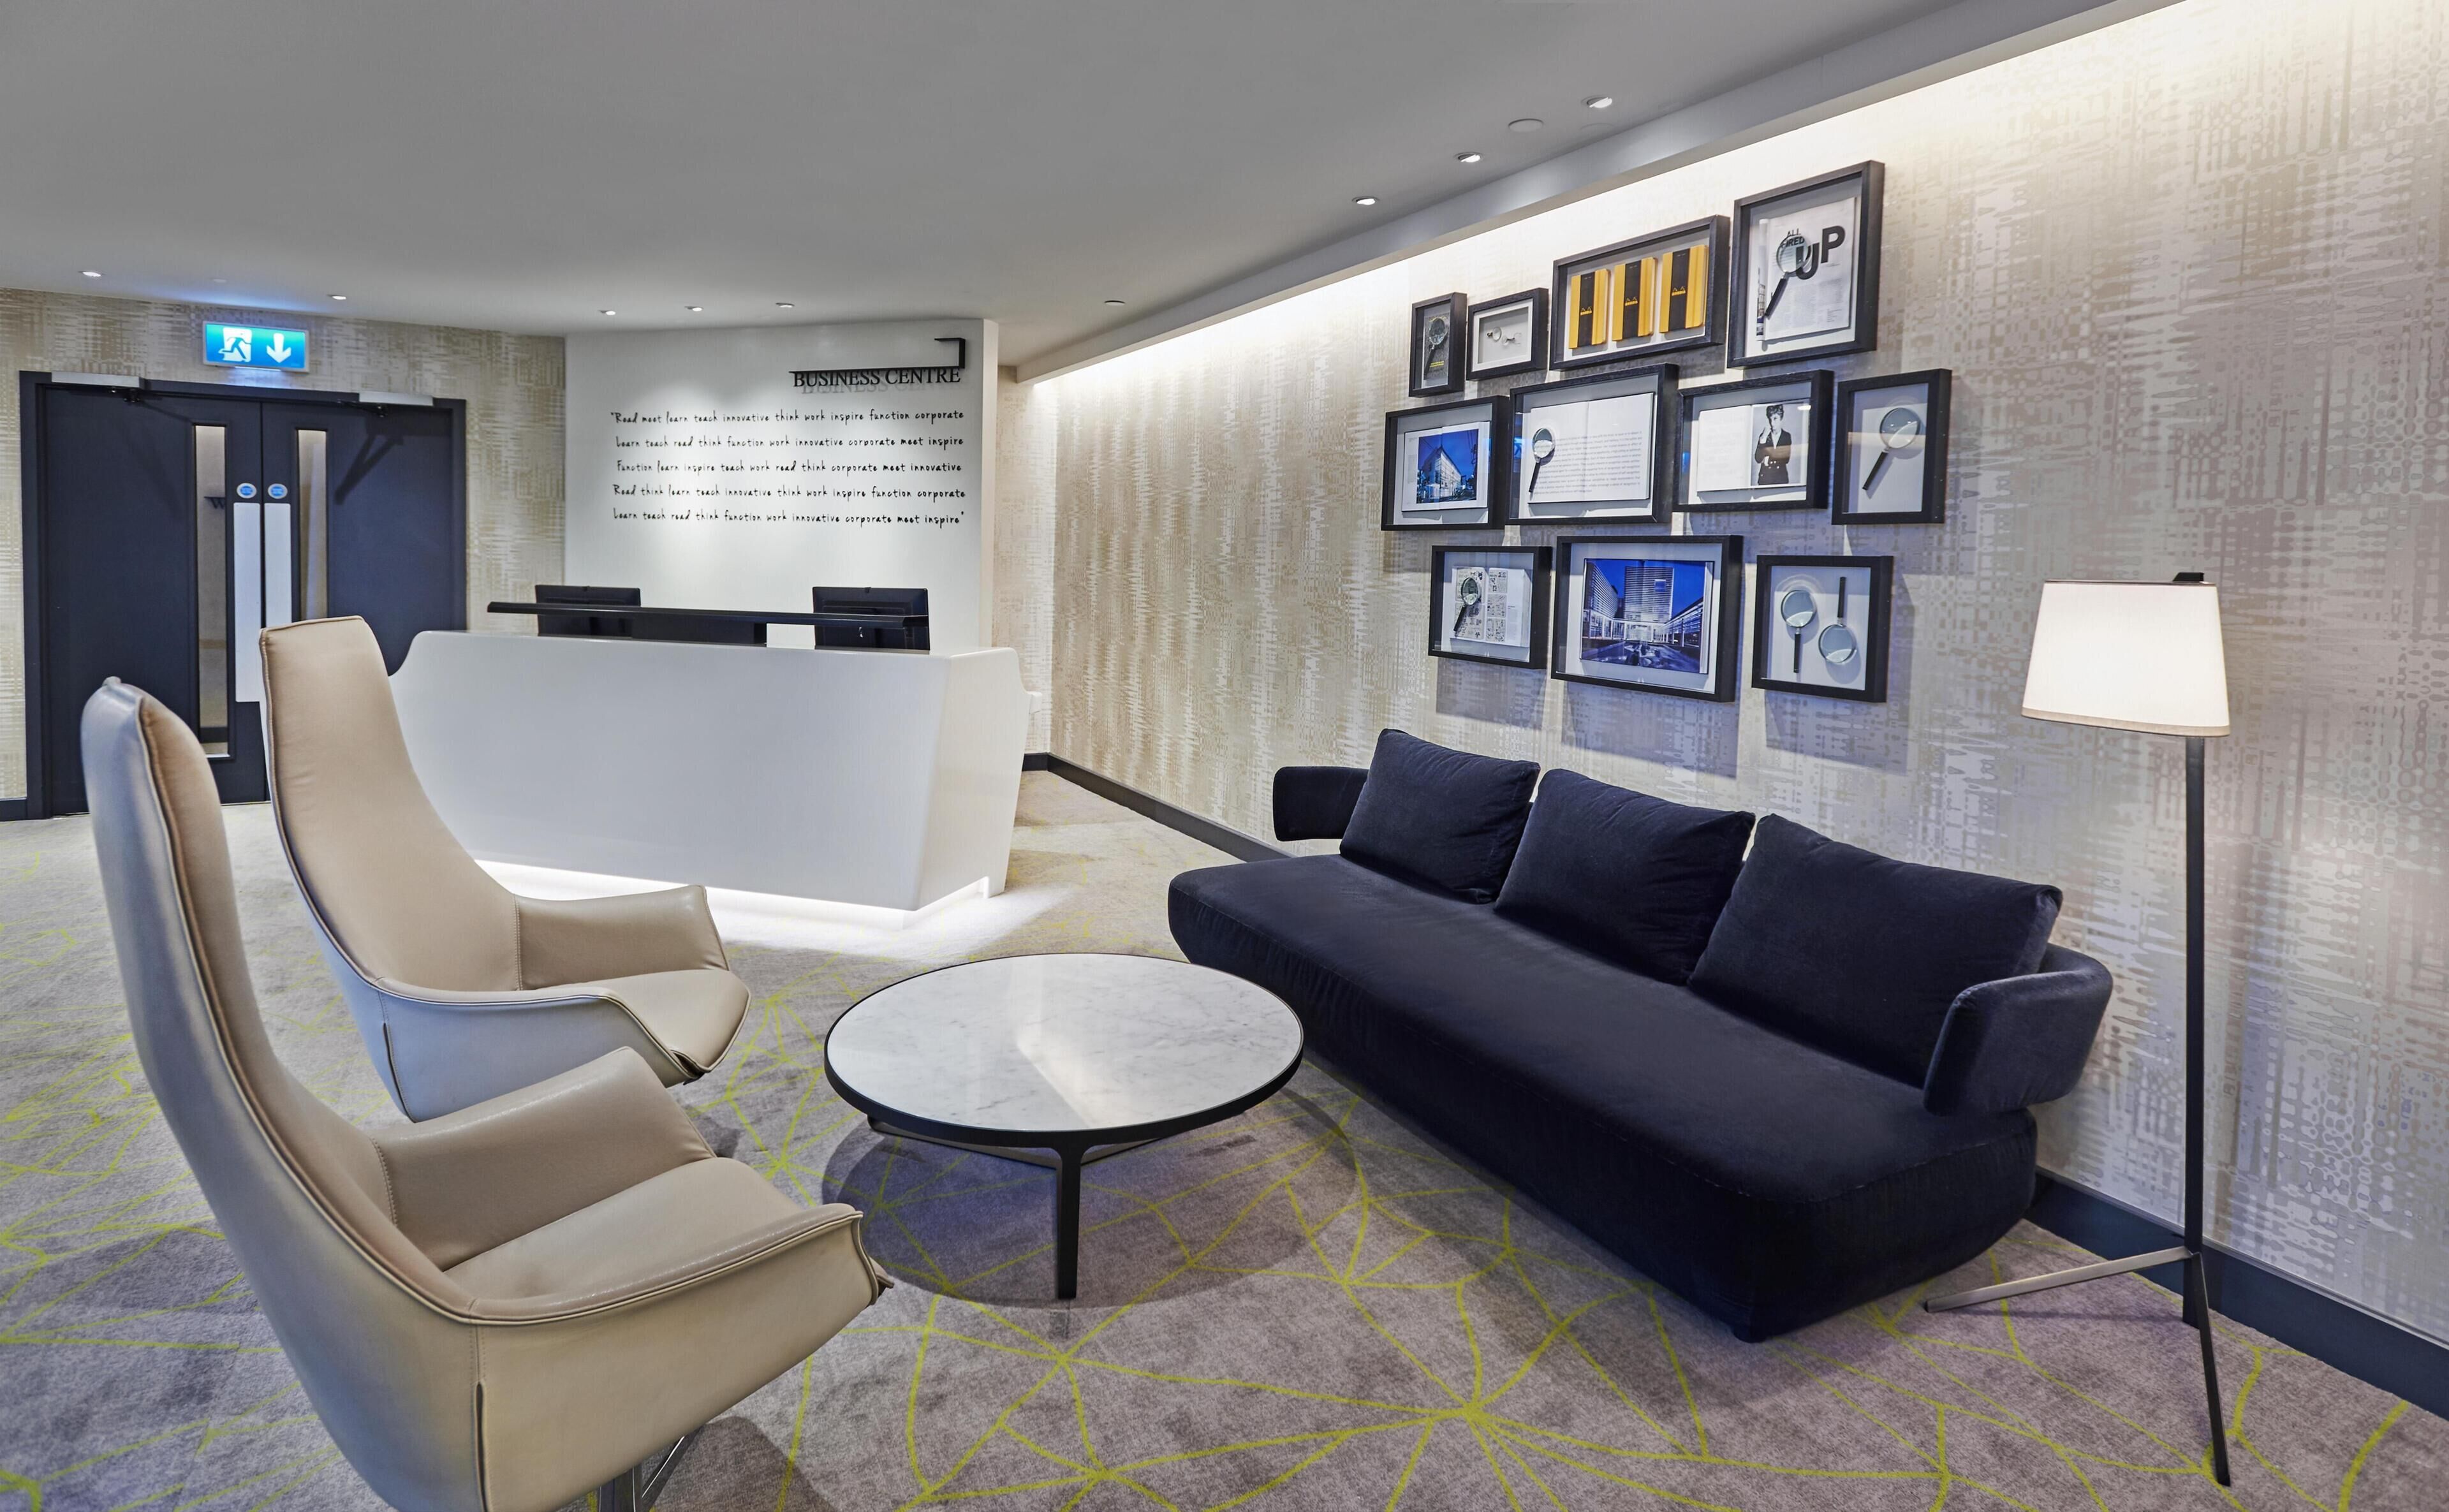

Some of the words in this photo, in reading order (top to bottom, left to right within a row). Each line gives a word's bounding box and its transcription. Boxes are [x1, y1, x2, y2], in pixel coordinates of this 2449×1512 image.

[793, 371, 880, 387] BUSINESS
[885, 368, 960, 384] CENTRE
[666, 411, 688, 424] learn
[695, 410, 717, 422] teach
[776, 409, 799, 421] think
[805, 409, 825, 421] work
[831, 412, 864, 425] inspire
[869, 409, 909, 421] function
[915, 410, 964, 425] corporate
[616, 436, 640, 447] Learn
[645, 436, 668, 447] teach
[674, 436, 693, 446] read
[699, 436, 721, 447] think
[727, 436, 763, 447] function
[770, 435, 790, 446] work
[796, 438, 843, 446] innovative
[849, 437, 895, 446] corporate
[901, 437, 923, 446] meet
[929, 436, 963, 451] inspire
[617, 460, 652, 471] Function
[658, 460, 679, 473] learn
[685, 464, 714, 476] inspire
[721, 460, 744, 471] teach
[750, 460, 770, 471] work
[776, 460, 796, 471] read
[802, 459, 826, 471] think
[832, 464, 878, 476] corporate
[883, 464, 906, 472] meet
[911, 463, 961, 471] innovative
[613, 484, 636, 495] Read
[641, 484, 663, 495] think
[669, 485, 689, 495] learn
[696, 485, 719, 496] teach
[777, 485, 801, 497] think
[807, 485, 827, 497] work
[834, 490, 865, 501] inspire
[872, 486, 911, 497] function
[918, 489, 966, 503] corporate
[614, 508, 637, 518] Learn
[643, 508, 665, 520] teach
[672, 510, 690, 520] read
[696, 510, 718, 520] think
[724, 510, 761, 521] function
[767, 510, 786, 521] work
[793, 514, 839, 522] innovative
[846, 515, 892, 527] corporate
[897, 515, 920, 524] meet
